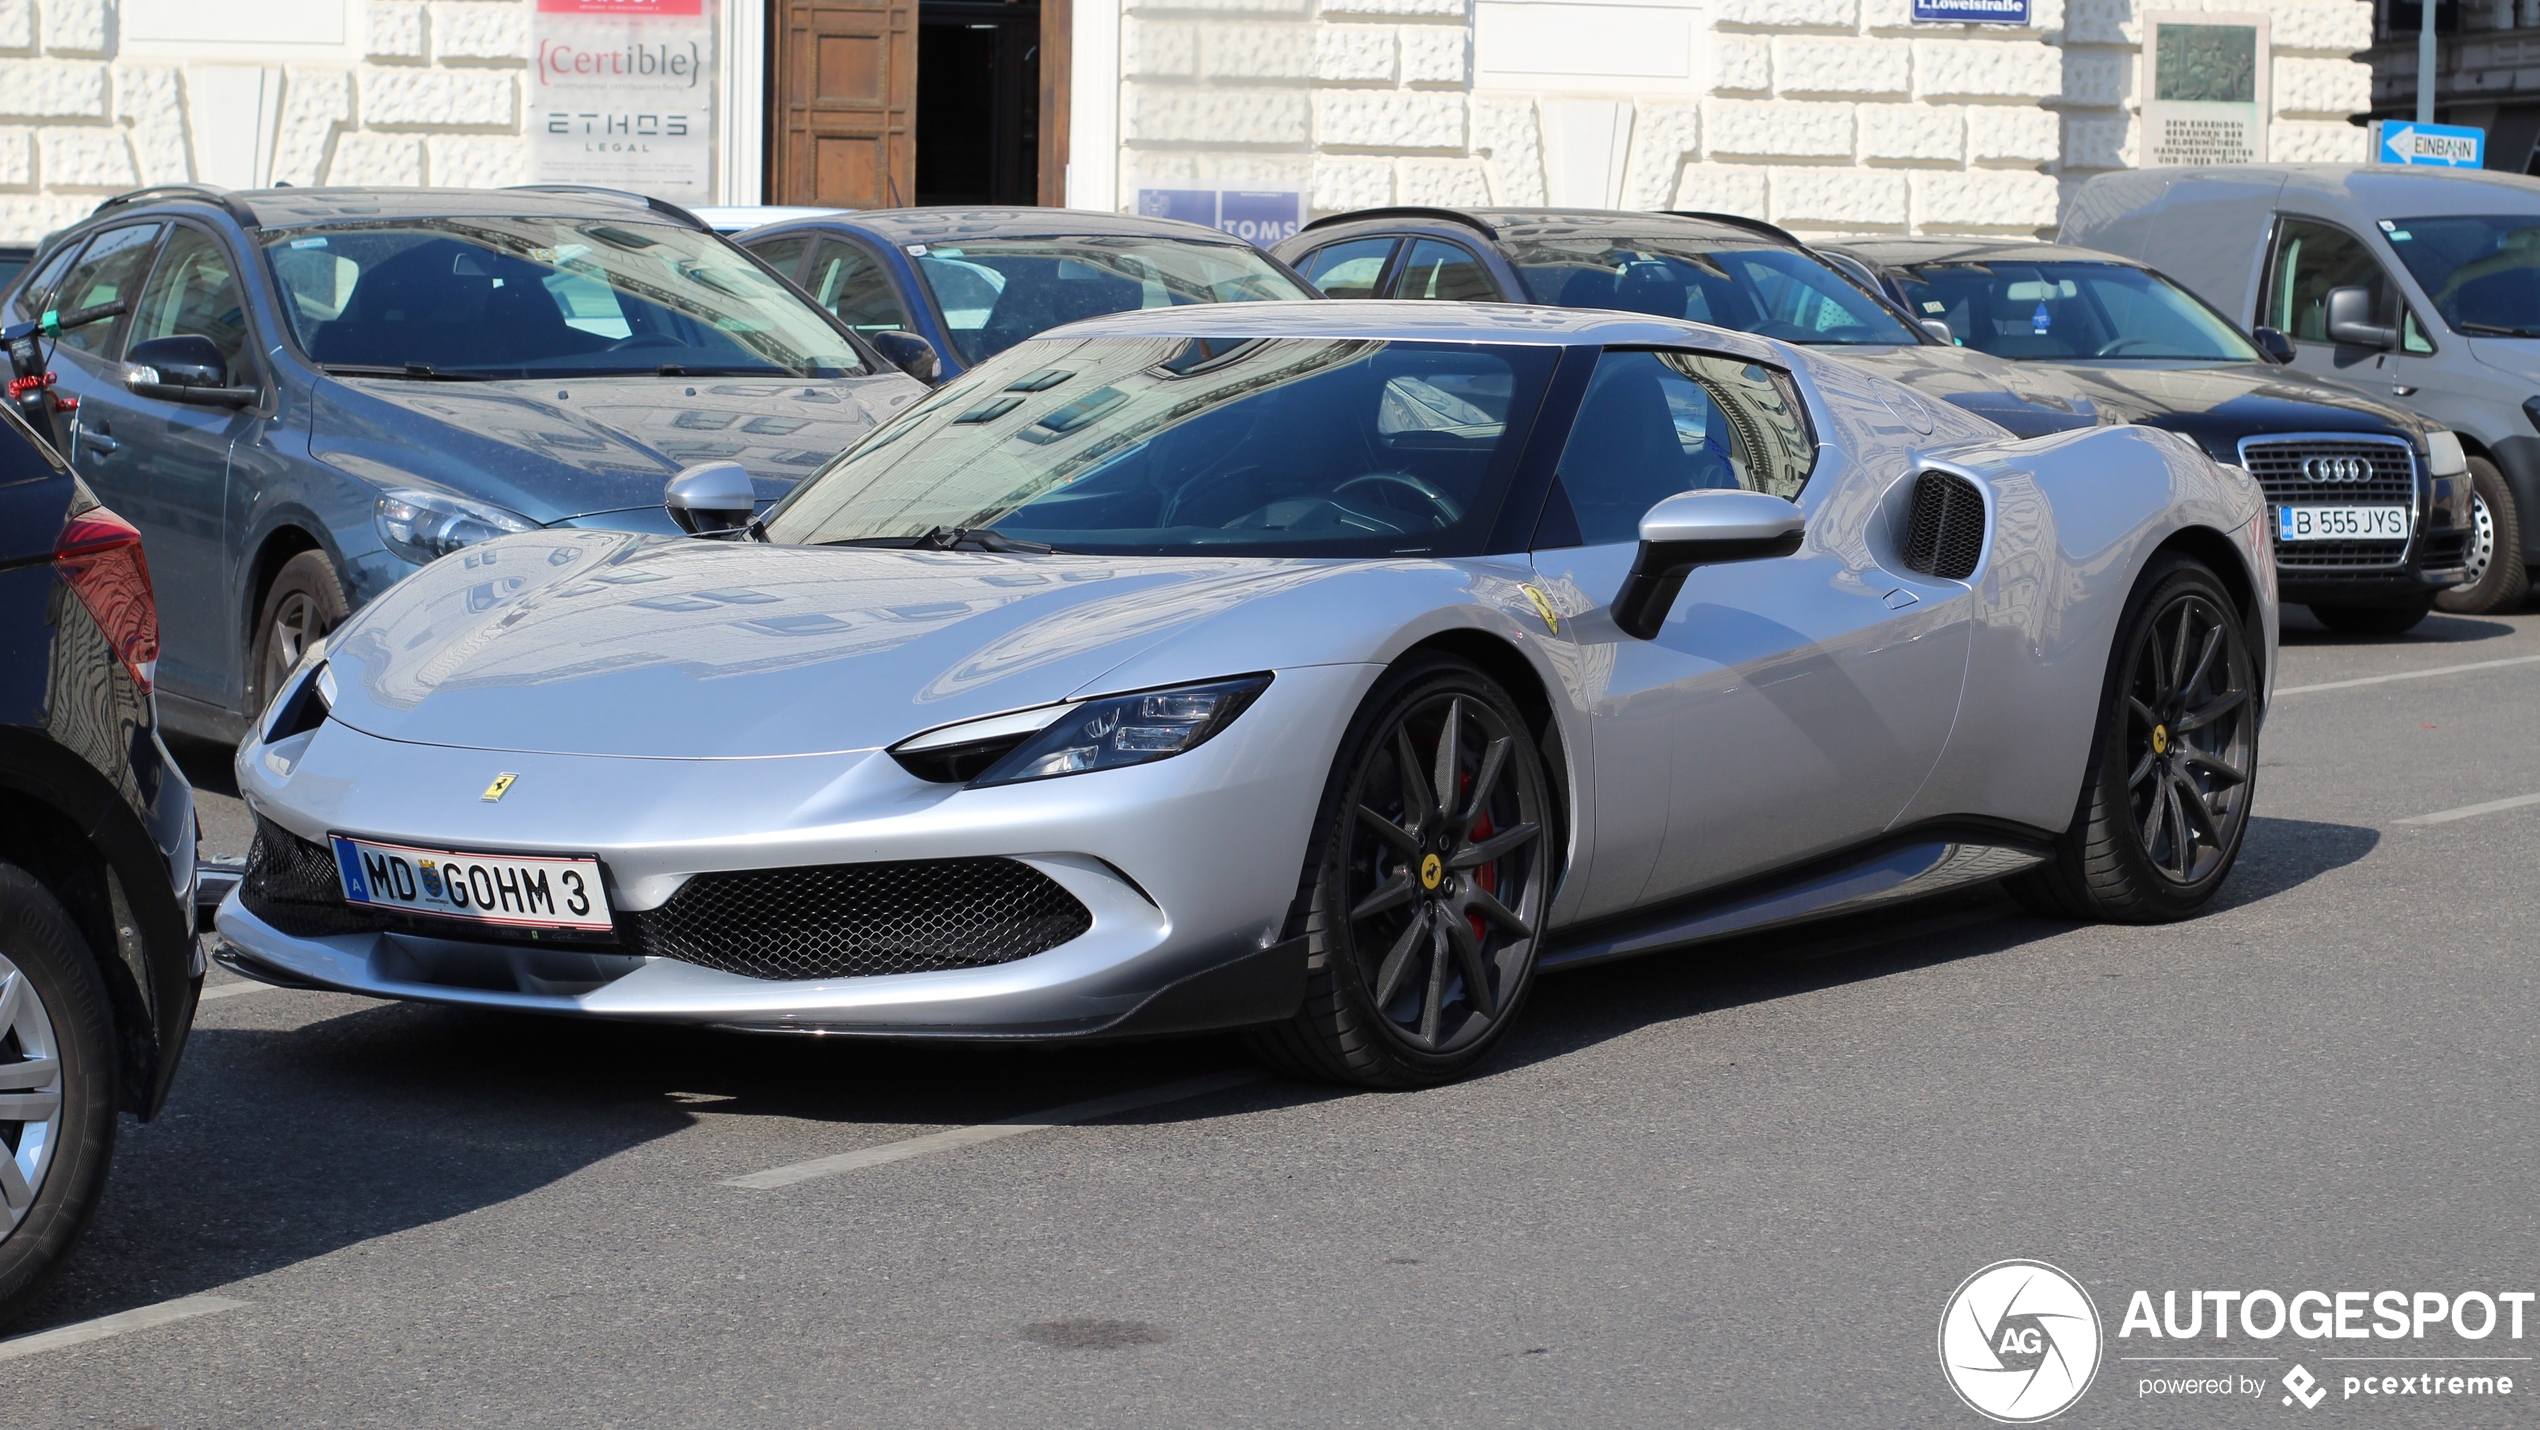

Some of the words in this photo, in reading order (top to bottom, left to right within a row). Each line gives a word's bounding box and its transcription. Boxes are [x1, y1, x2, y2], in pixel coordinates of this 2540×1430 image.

[548, 113, 687, 135] ETHOS
[2165, 129, 2220, 137] GEDENKEN
[586, 142, 650, 152] LEGAL
[2415, 136, 2472, 158] EINBAHN
[1223, 220, 1297, 240] TOMS
[2282, 526, 2293, 536] RO
[2297, 511, 2311, 534] B
[2320, 510, 2358, 533] 555
[2363, 510, 2402, 533] JYS
[352, 881, 363, 893] A
[363, 850, 417, 901] MD
[443, 862, 556, 915] GOHM
[562, 869, 590, 916] 3
